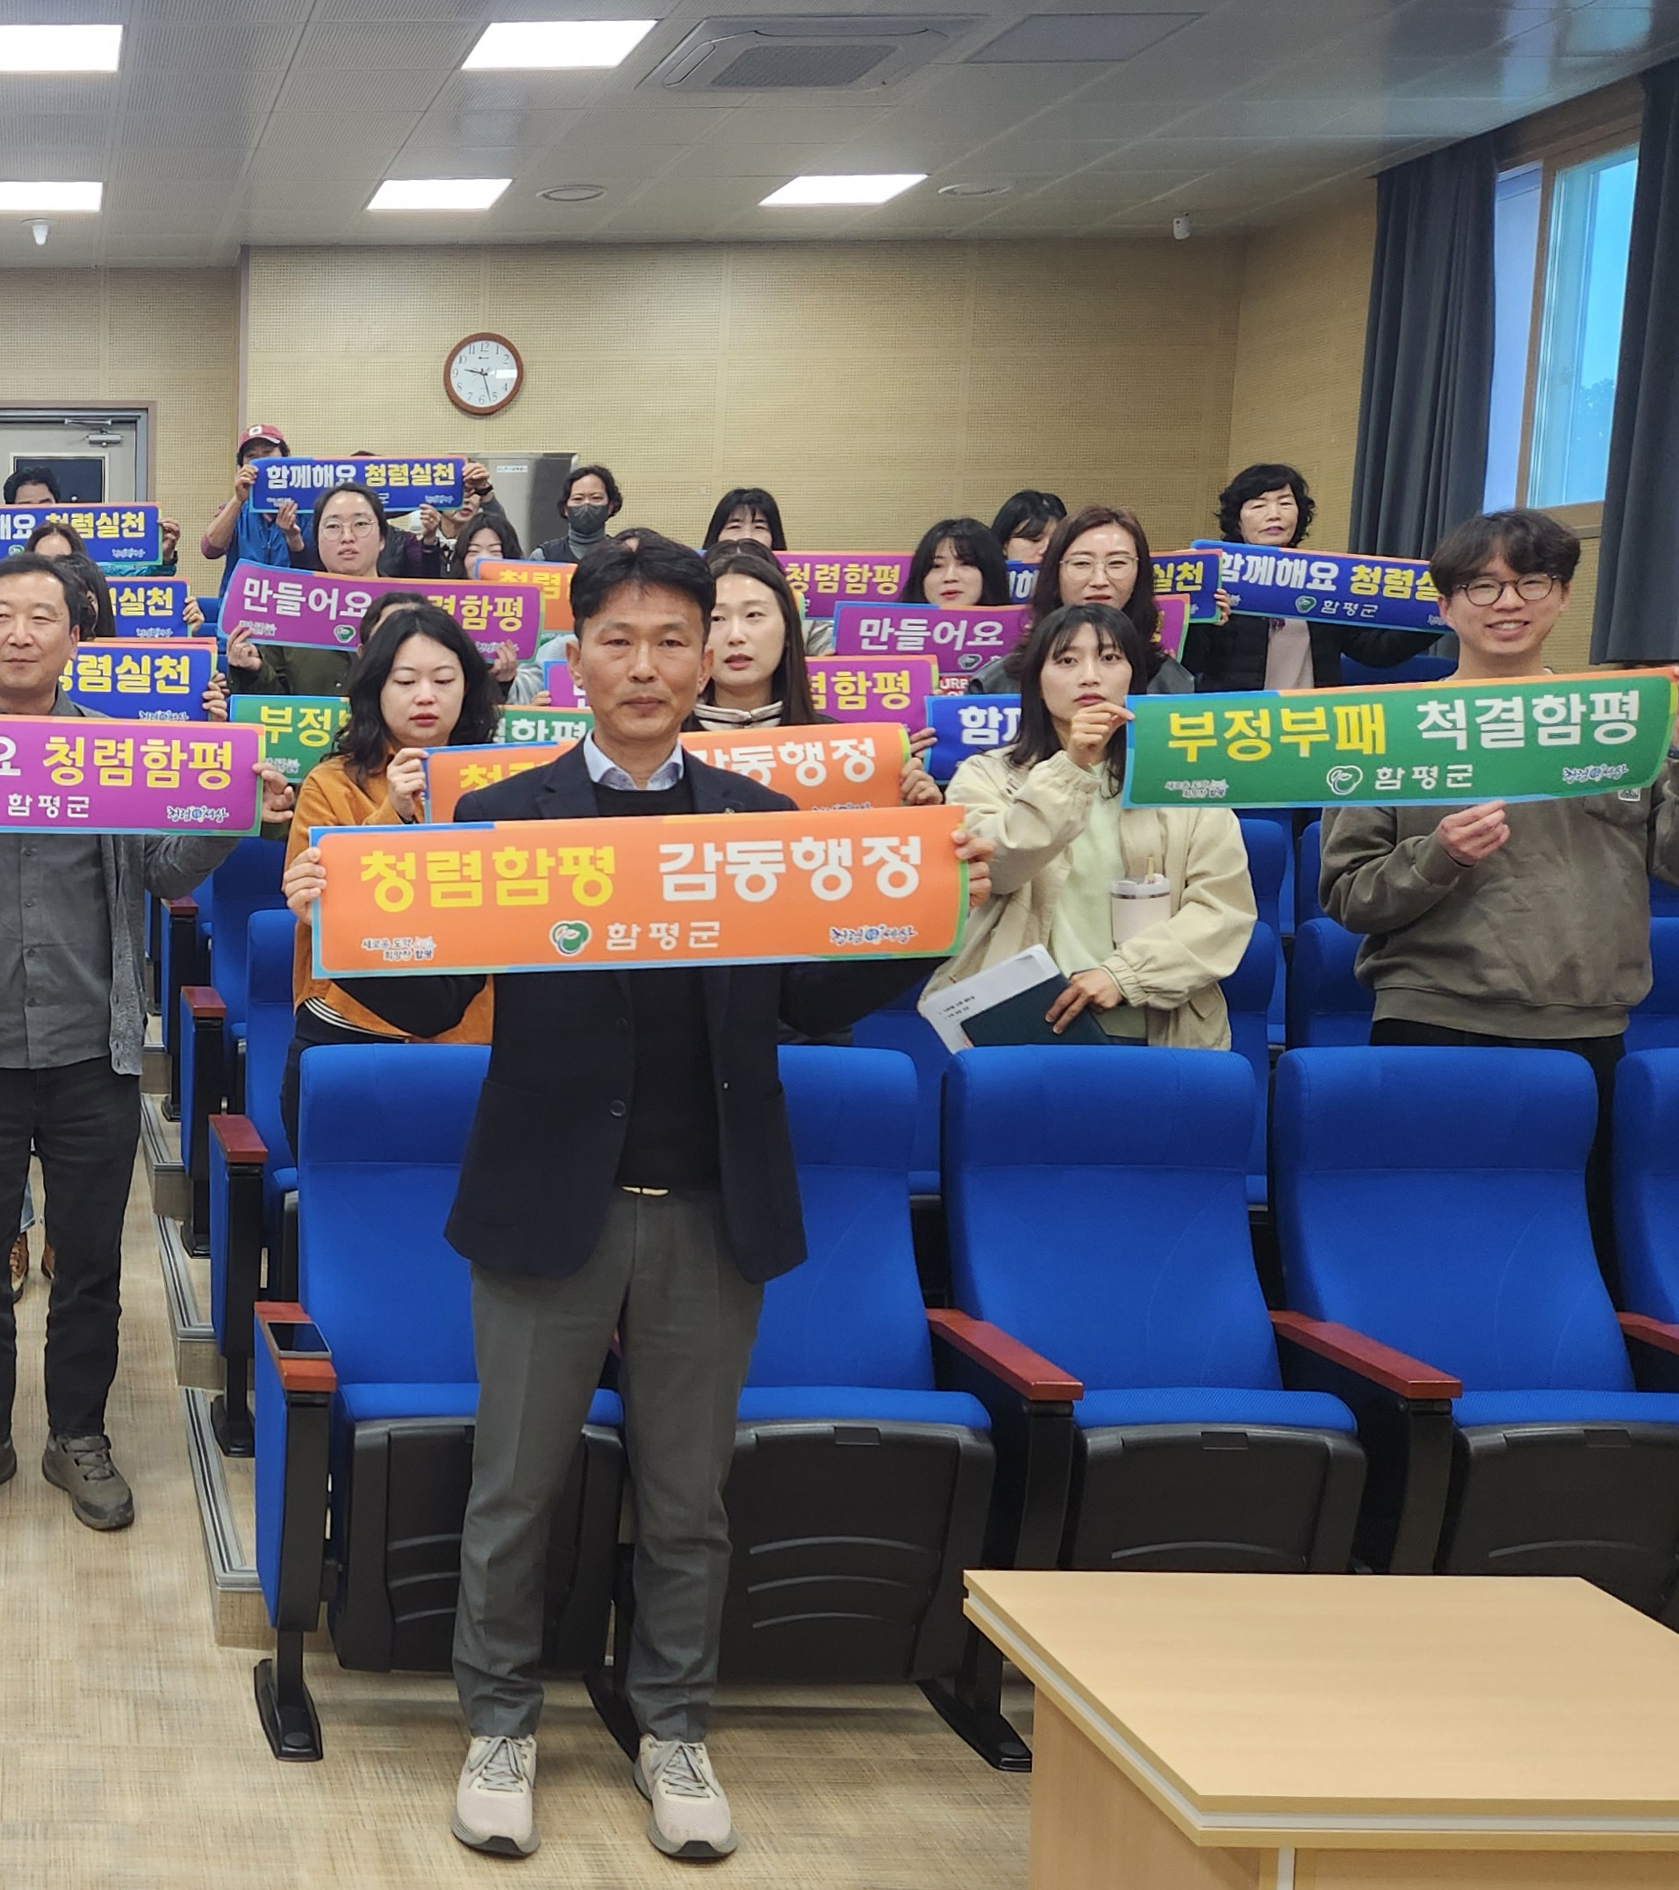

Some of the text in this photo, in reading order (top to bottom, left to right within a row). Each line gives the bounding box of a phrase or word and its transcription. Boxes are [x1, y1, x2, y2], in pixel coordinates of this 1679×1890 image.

[266, 463, 455, 489] 함께해요 청렴실천
[785, 563, 901, 596] 청렴함평
[243, 577, 373, 621] 만들어요
[1320, 599, 1379, 619] 함평군
[859, 618, 1004, 651] 만들어요
[61, 654, 190, 694] 렴실천
[1168, 690, 1640, 763] 부정부패 척결함평
[42, 735, 233, 790] 청렴함평
[1374, 764, 1473, 790] 함평군
[7, 793, 90, 819] 함평군
[360, 836, 922, 913] 청렴함평 감동행정
[606, 921, 721, 951] 함평군
